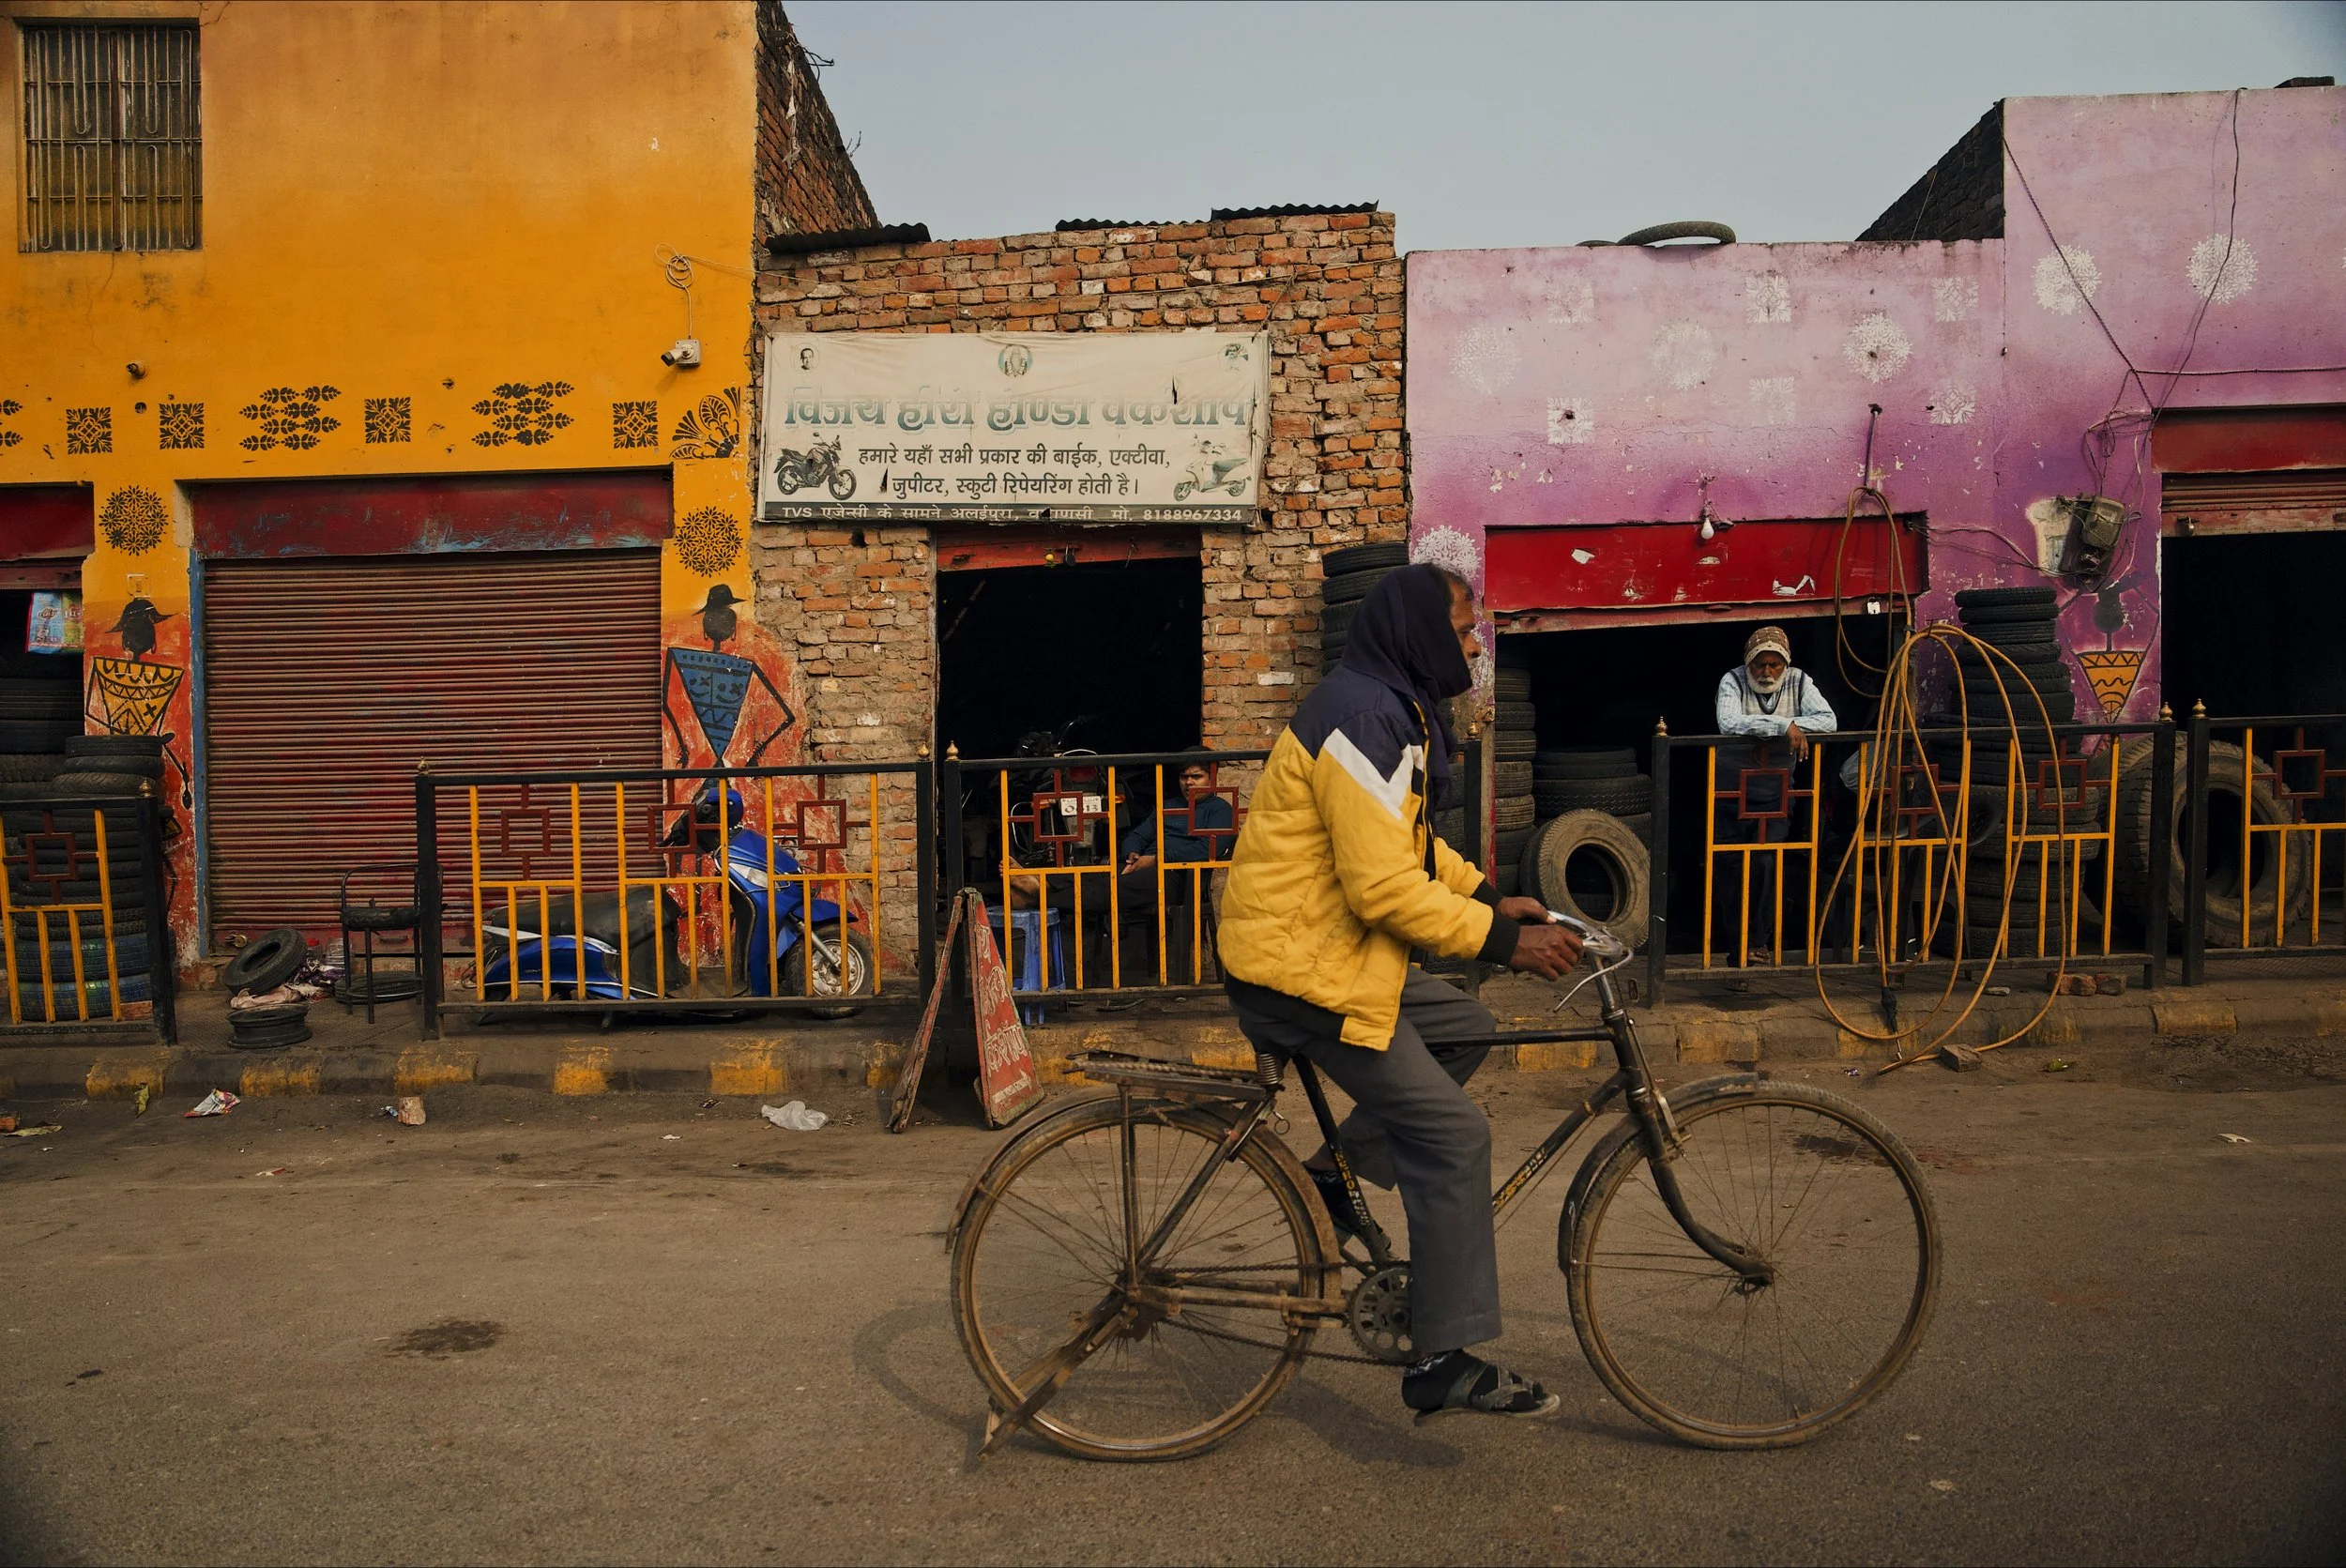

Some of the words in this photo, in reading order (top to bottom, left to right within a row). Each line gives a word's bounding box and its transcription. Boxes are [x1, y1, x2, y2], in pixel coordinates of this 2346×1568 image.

[859, 442, 899, 464] हमारे
[904, 444, 934, 464] यहाँ
[938, 443, 973, 464] सभी
[979, 449, 1021, 464] प्रकार
[1027, 443, 1047, 464] की
[1053, 442, 1102, 467] बाईक,
[1109, 443, 1170, 468] एक्टीवा,
[892, 472, 949, 499] जुपीटर,
[956, 472, 998, 500] स्कुटी
[1003, 472, 1073, 494] रिपेयरिंग
[1078, 472, 1112, 495] होती
[782, 507, 813, 518] TVS
[821, 503, 869, 519] एजेन्सी
[876, 504, 893, 519] के
[901, 504, 942, 519] सामने
[1111, 505, 1133, 521] मो.
[1142, 509, 1242, 521] 8188967334
